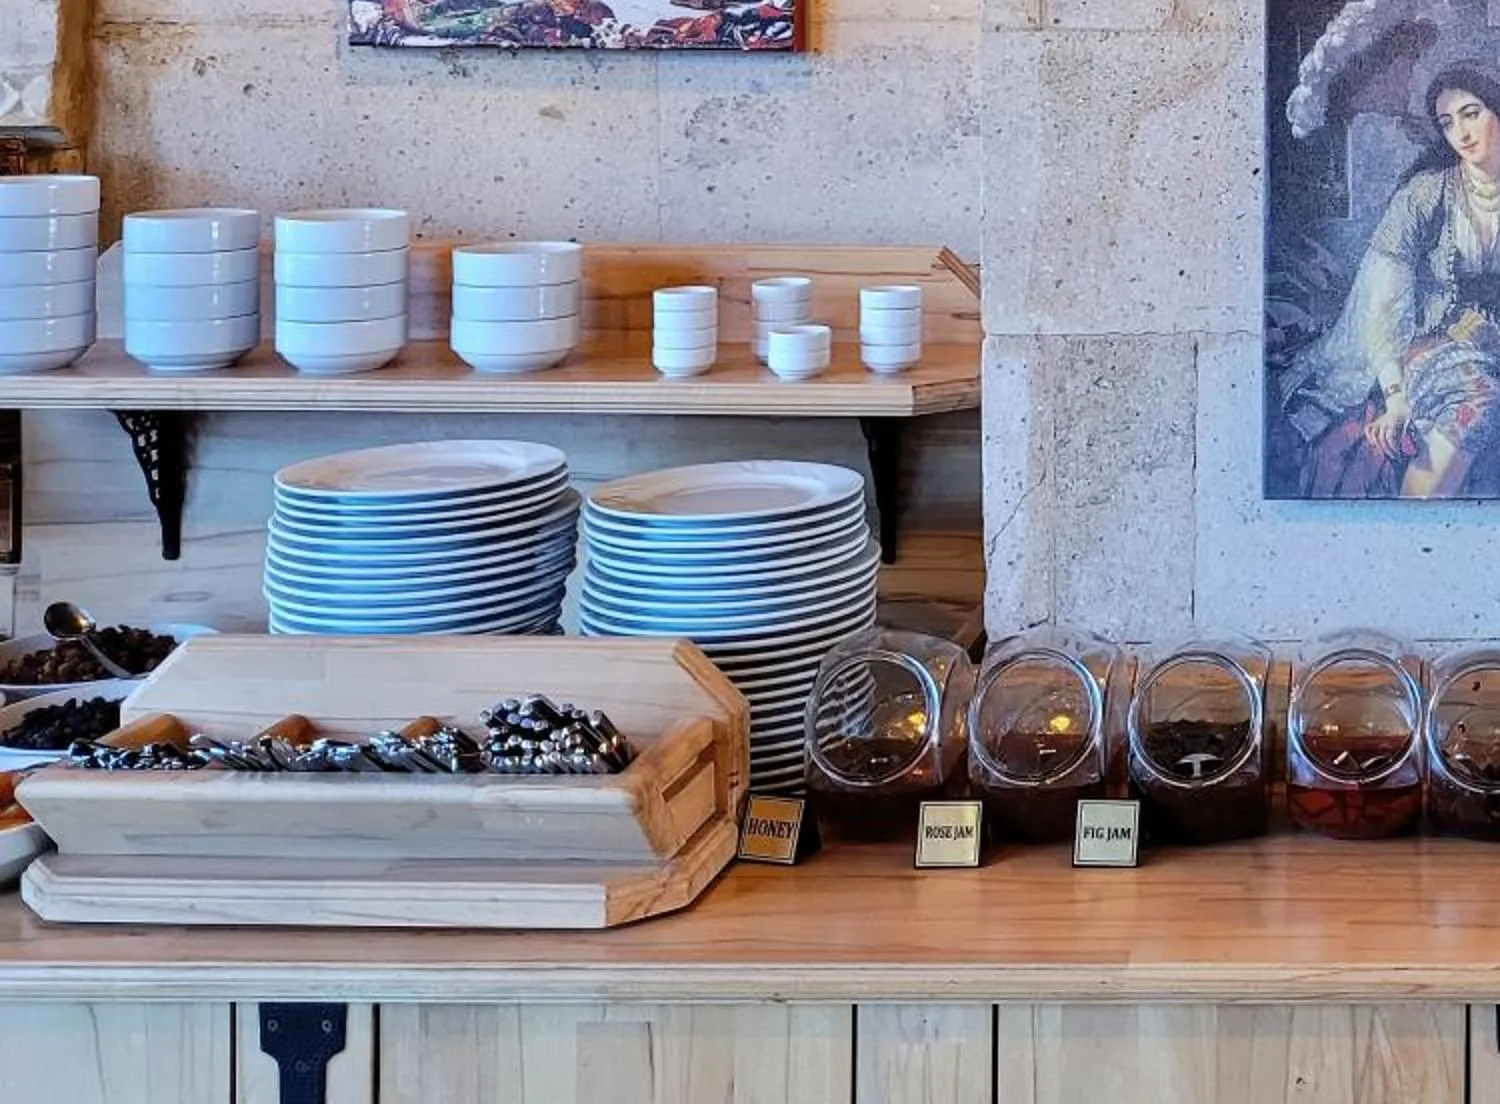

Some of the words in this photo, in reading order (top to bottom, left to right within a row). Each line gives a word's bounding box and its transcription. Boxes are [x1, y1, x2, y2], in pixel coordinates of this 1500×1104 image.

[748, 817, 796, 839] HONEY
[925, 825, 952, 839] ROSE
[953, 825, 974, 841] JAM
[1083, 826, 1104, 839] FIG
[1106, 826, 1131, 842] JAM
